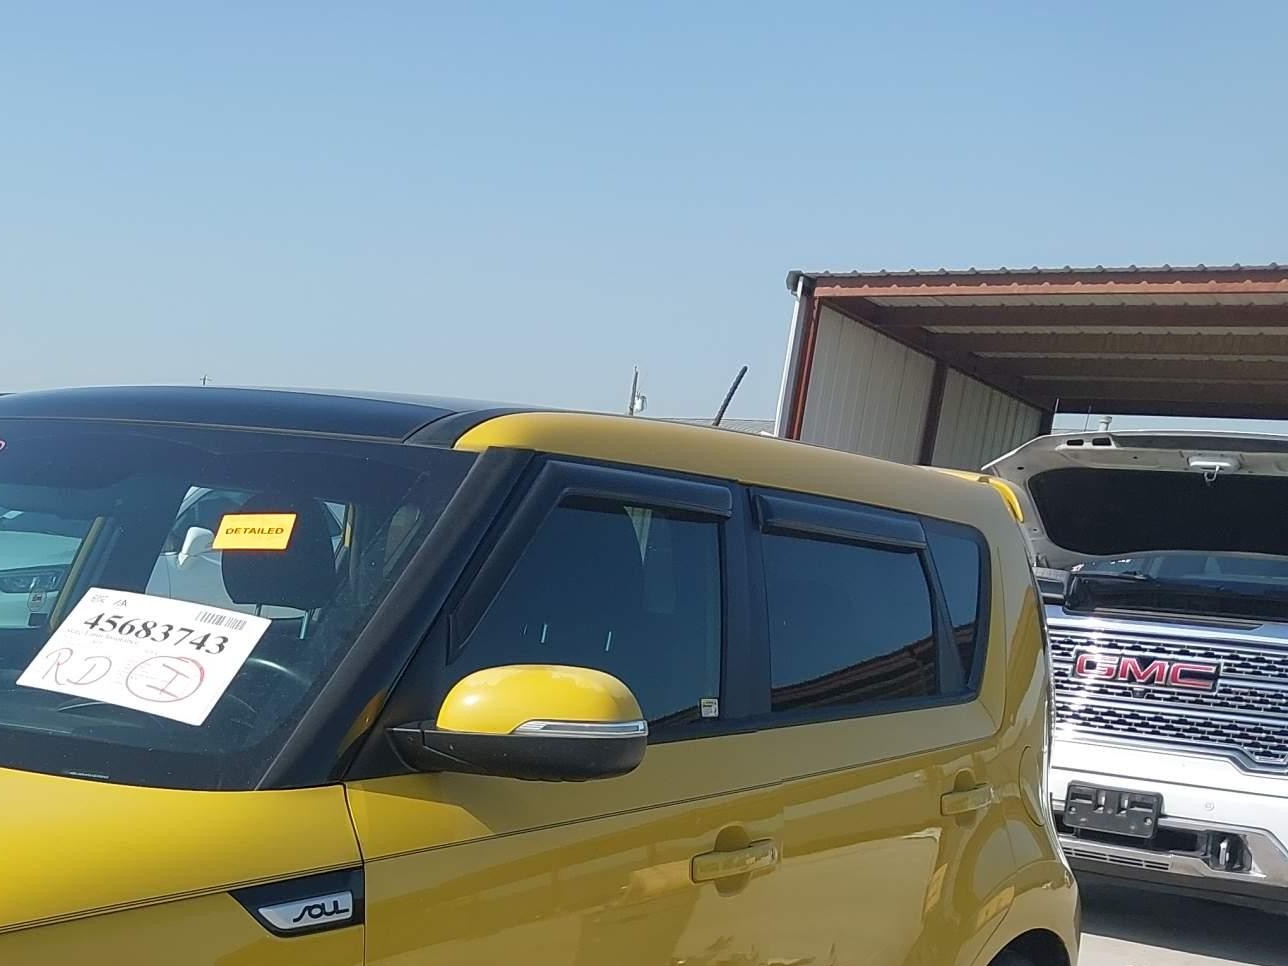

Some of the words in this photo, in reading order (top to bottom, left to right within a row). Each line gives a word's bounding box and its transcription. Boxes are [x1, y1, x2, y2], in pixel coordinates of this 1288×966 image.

[225, 527, 285, 535] DETAILED
[83, 612, 230, 655] 45683743
[1075, 653, 1217, 690] GMC
[292, 900, 350, 923] SOUL
